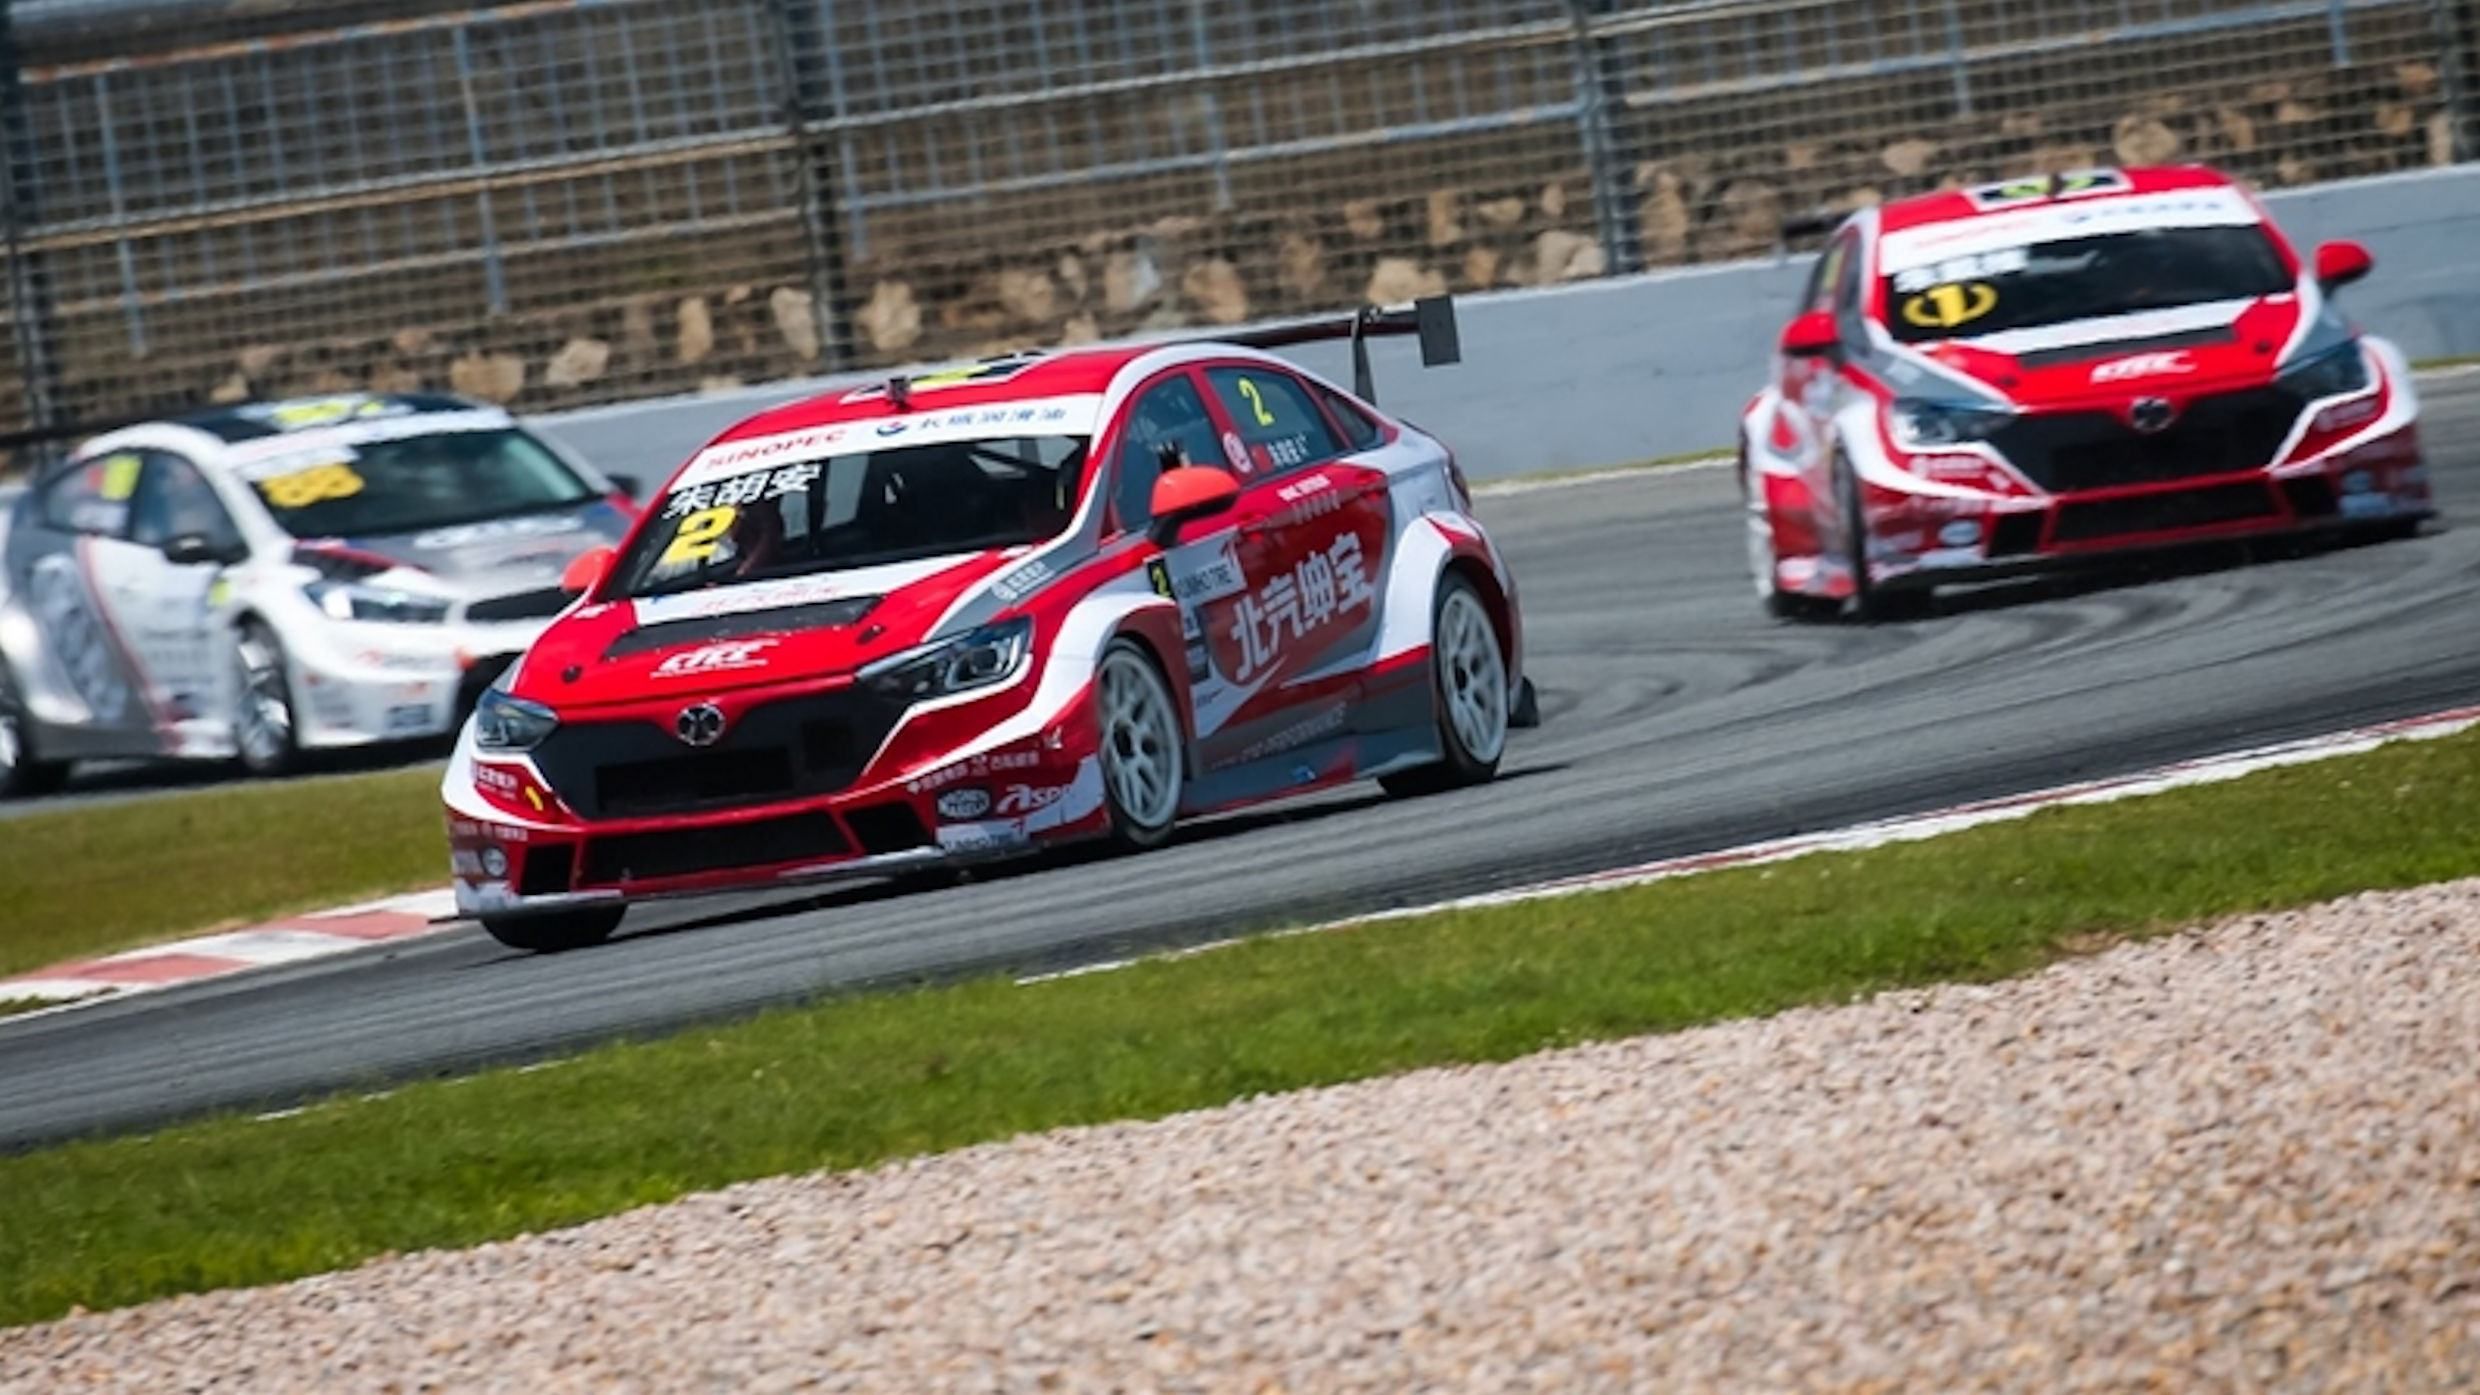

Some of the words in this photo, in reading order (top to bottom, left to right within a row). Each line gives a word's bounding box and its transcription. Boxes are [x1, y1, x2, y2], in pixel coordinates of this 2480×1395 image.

[1238, 376, 1275, 427] 2
[706, 428, 846, 470] SINOPEC
[667, 505, 738, 565] 2
[1151, 565, 1171, 598] 2
[1230, 531, 1376, 682] 北汽绅宝
